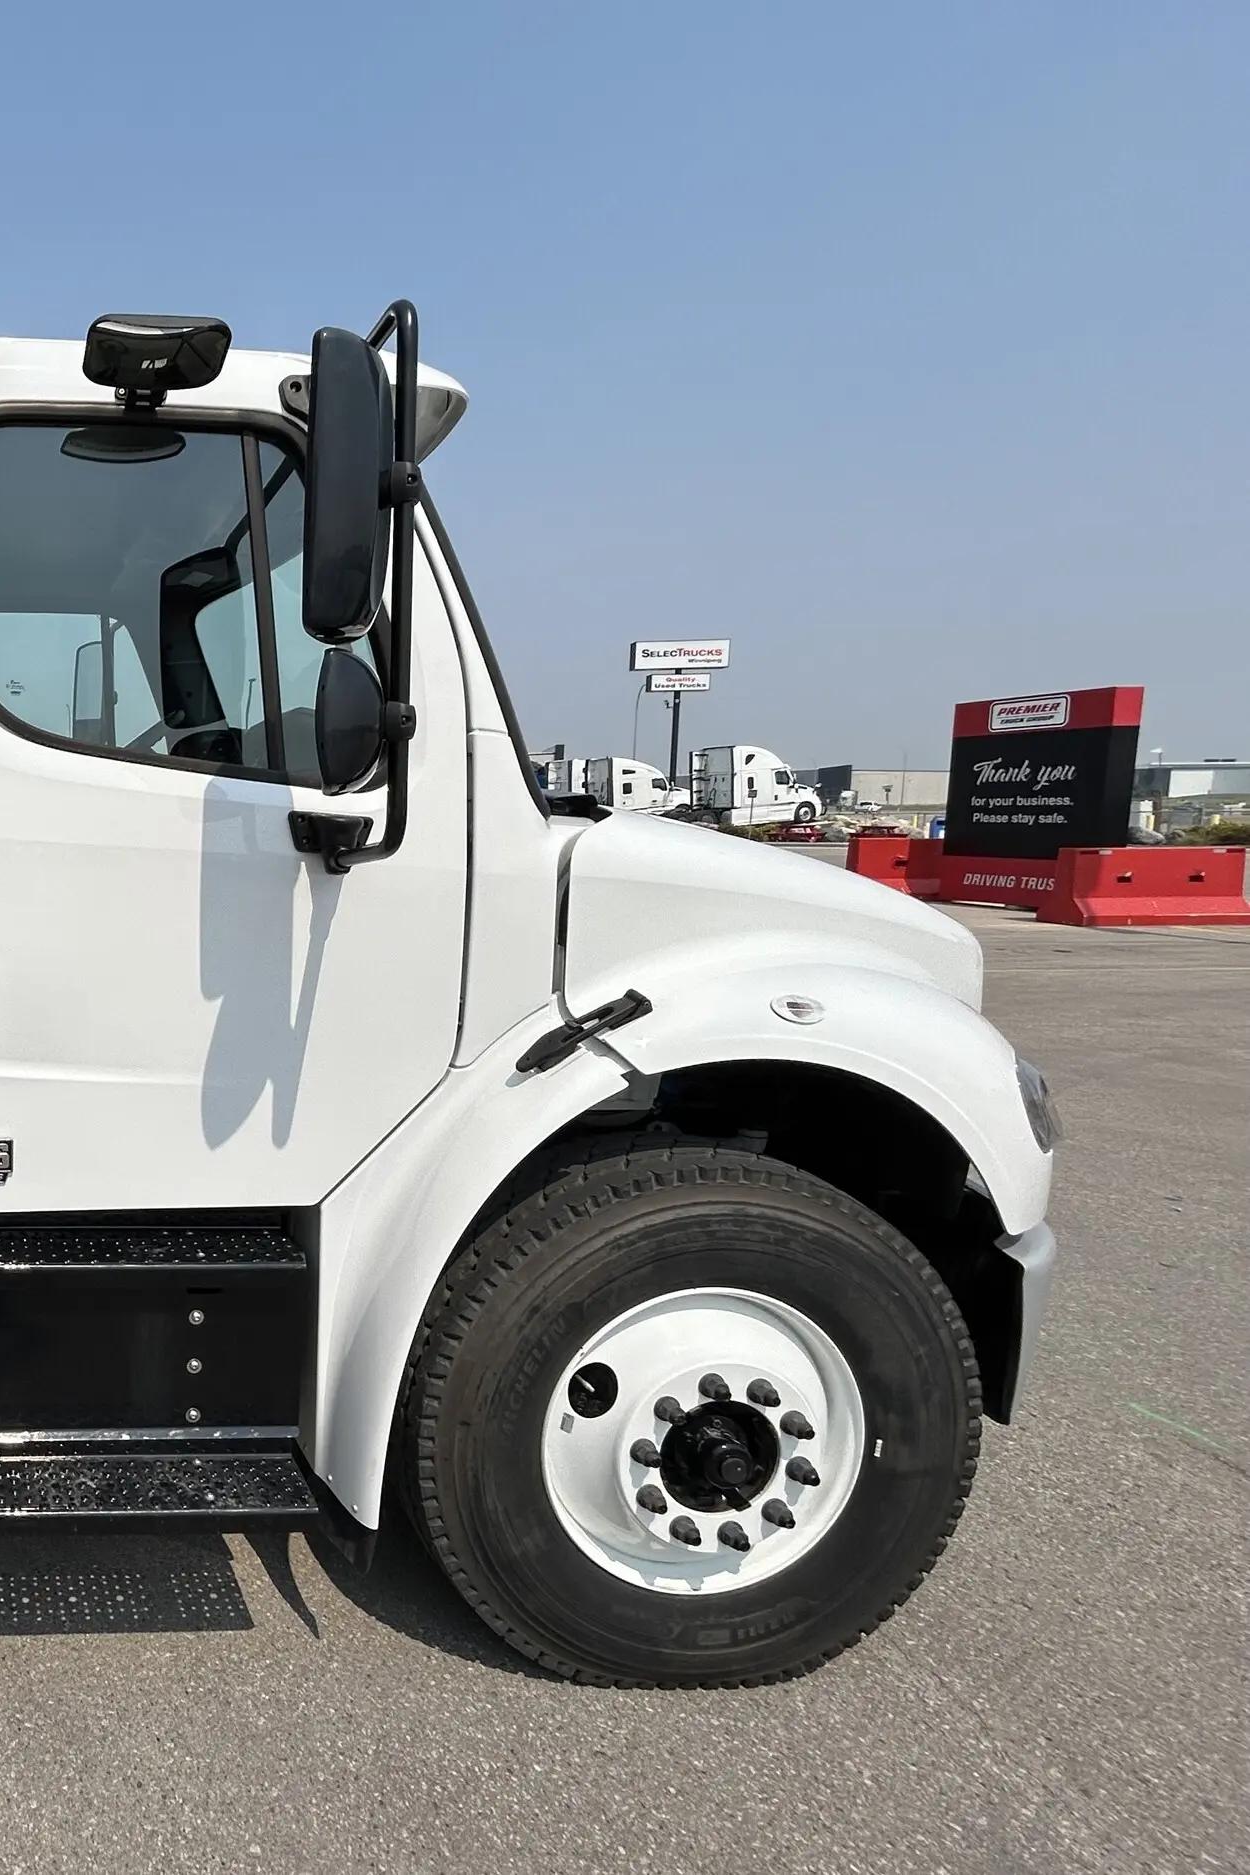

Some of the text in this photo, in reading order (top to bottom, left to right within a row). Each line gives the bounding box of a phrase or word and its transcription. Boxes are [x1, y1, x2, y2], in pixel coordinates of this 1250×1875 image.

[997, 702, 1061, 717] PREMIER
[973, 757, 1077, 791] Thank you
[971, 795, 1074, 808] for your business.
[972, 812, 1068, 825] Please stay safe.
[963, 873, 1055, 891] DRIVING TRUS
